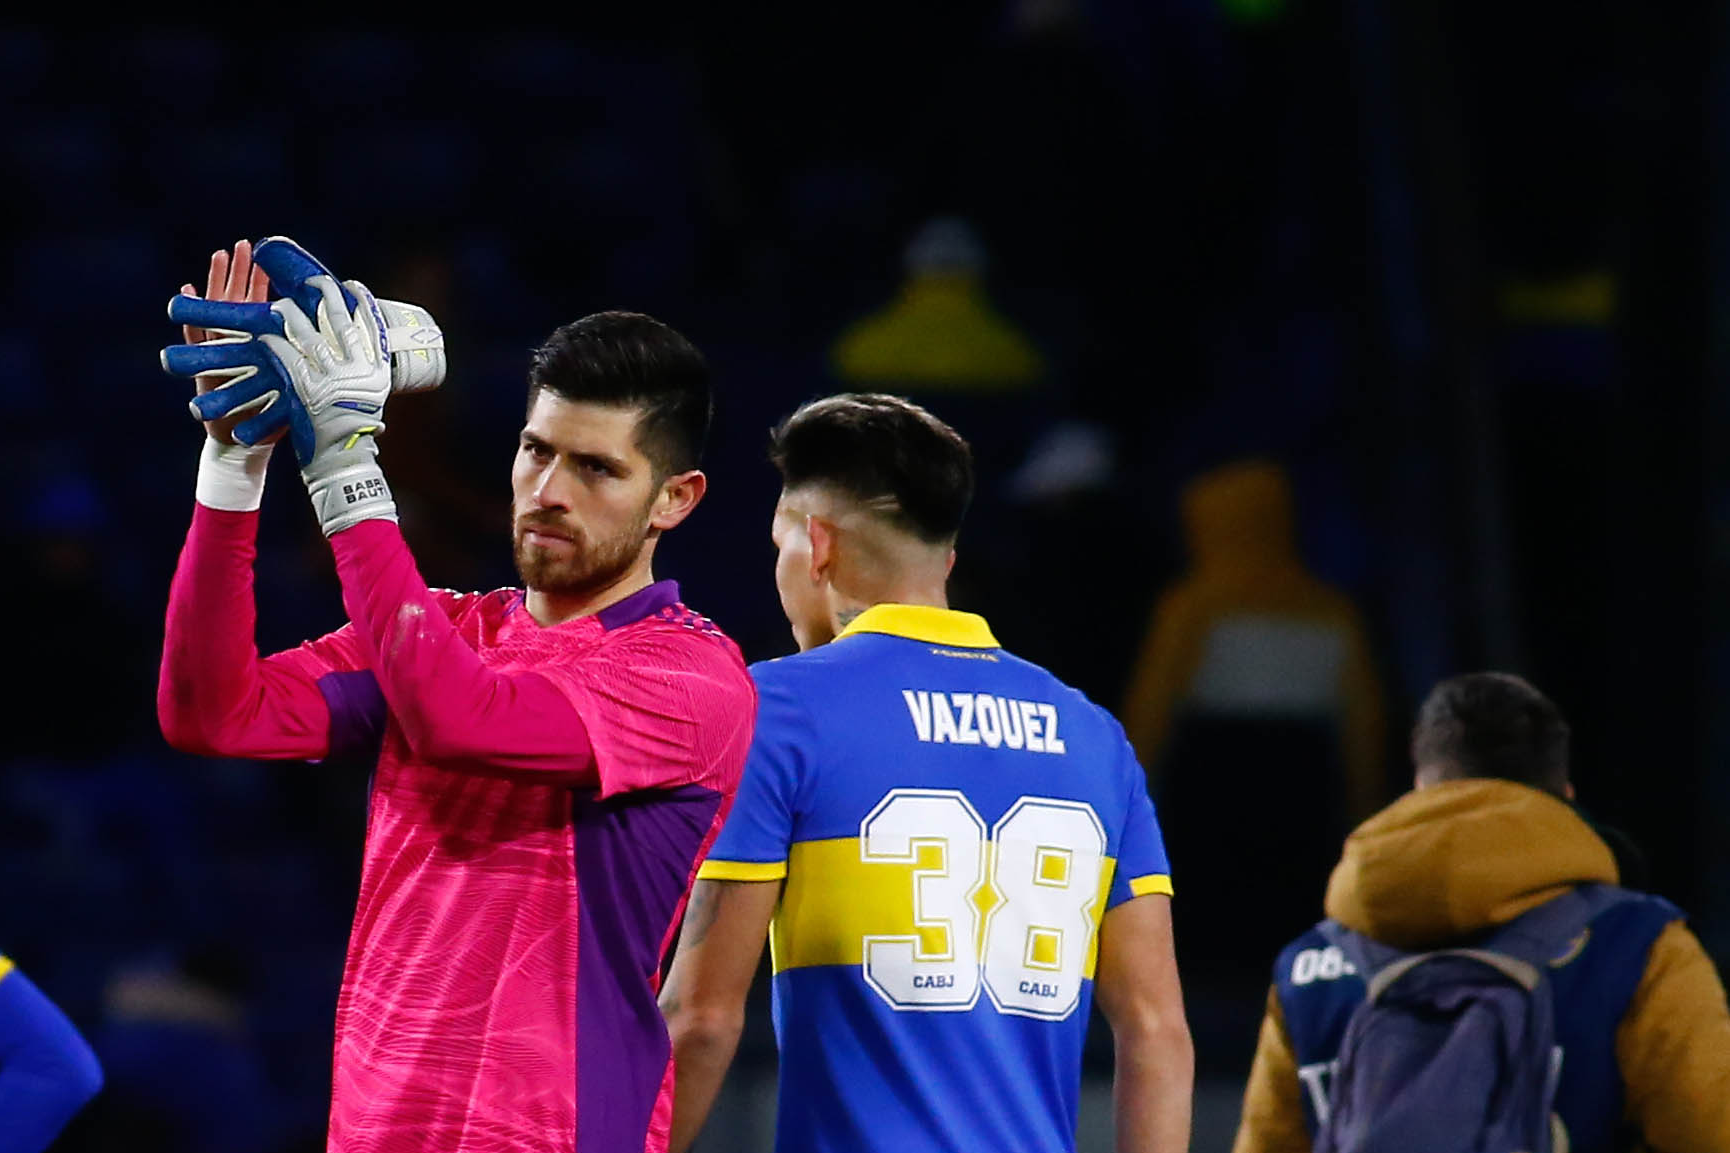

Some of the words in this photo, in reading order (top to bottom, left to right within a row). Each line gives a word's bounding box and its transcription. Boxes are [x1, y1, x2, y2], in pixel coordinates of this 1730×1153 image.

[858, 787, 1109, 1021] 38
[913, 975, 955, 988] CABJ
[1019, 981, 1059, 998] CABJ
